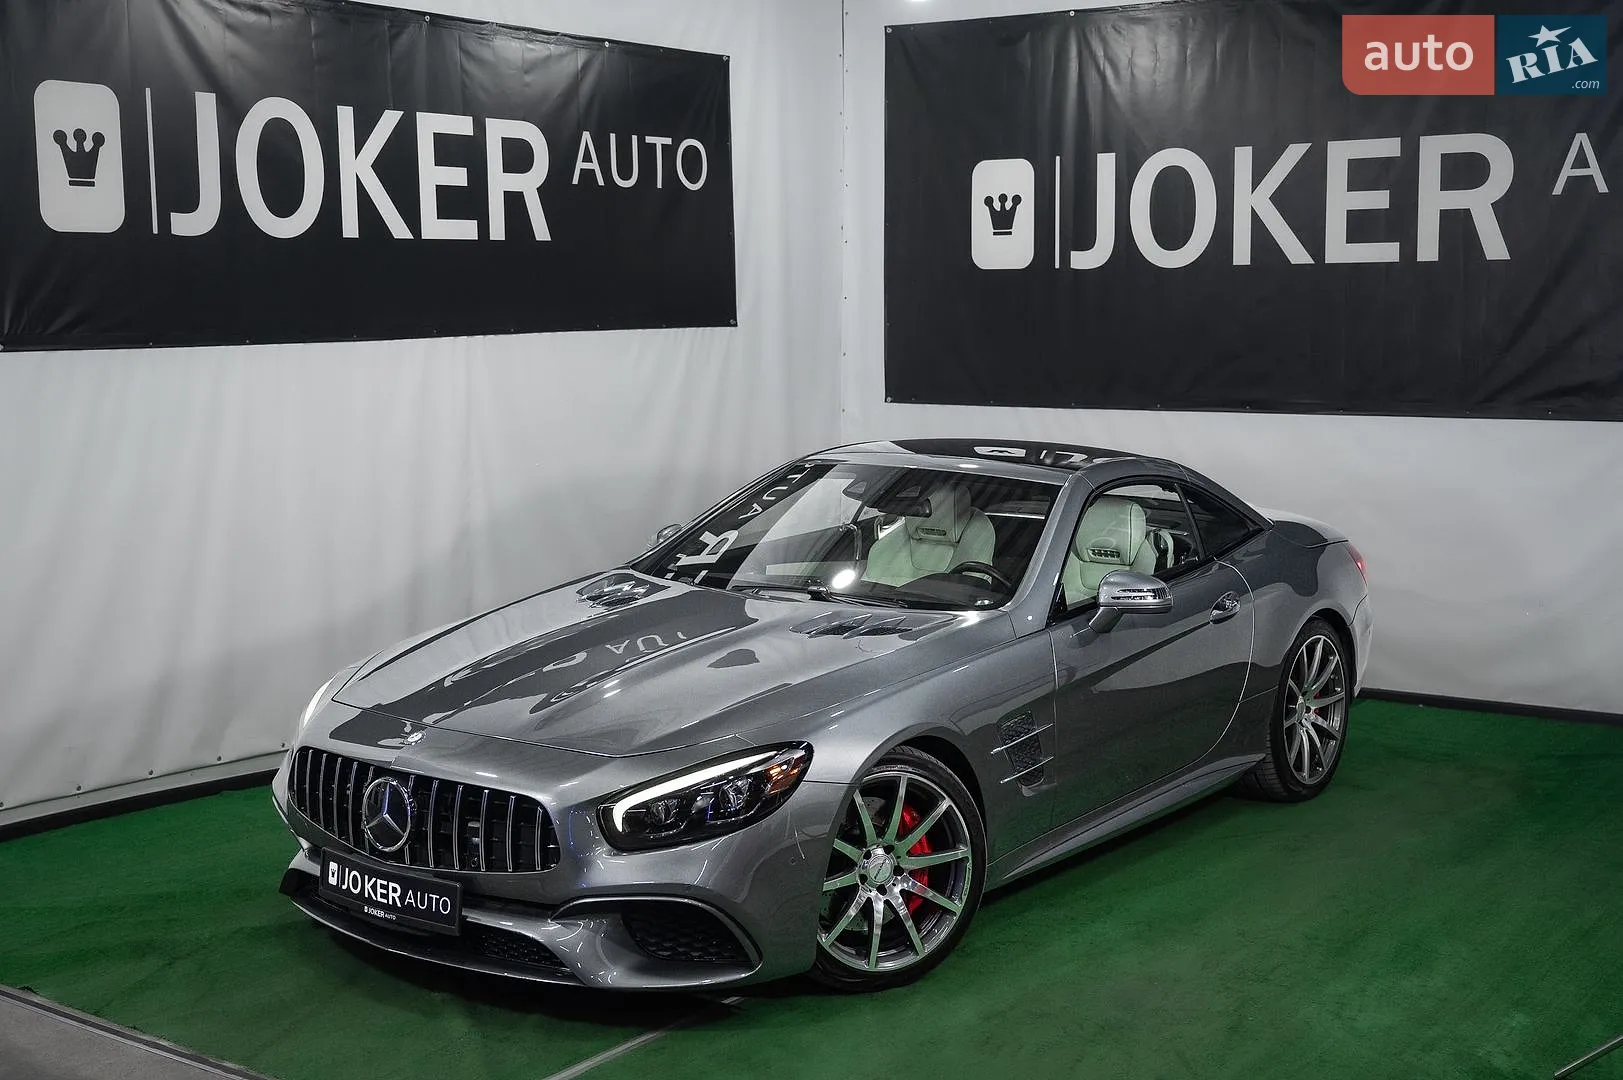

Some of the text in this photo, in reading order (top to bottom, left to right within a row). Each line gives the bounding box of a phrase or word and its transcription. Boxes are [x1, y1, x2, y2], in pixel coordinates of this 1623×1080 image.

[170, 91, 708, 241] JOKER AUTO
[1070, 132, 1609, 269] JOKER A
[341, 867, 451, 915] JOKER AUTO
[368, 907, 385, 919] JOKER
